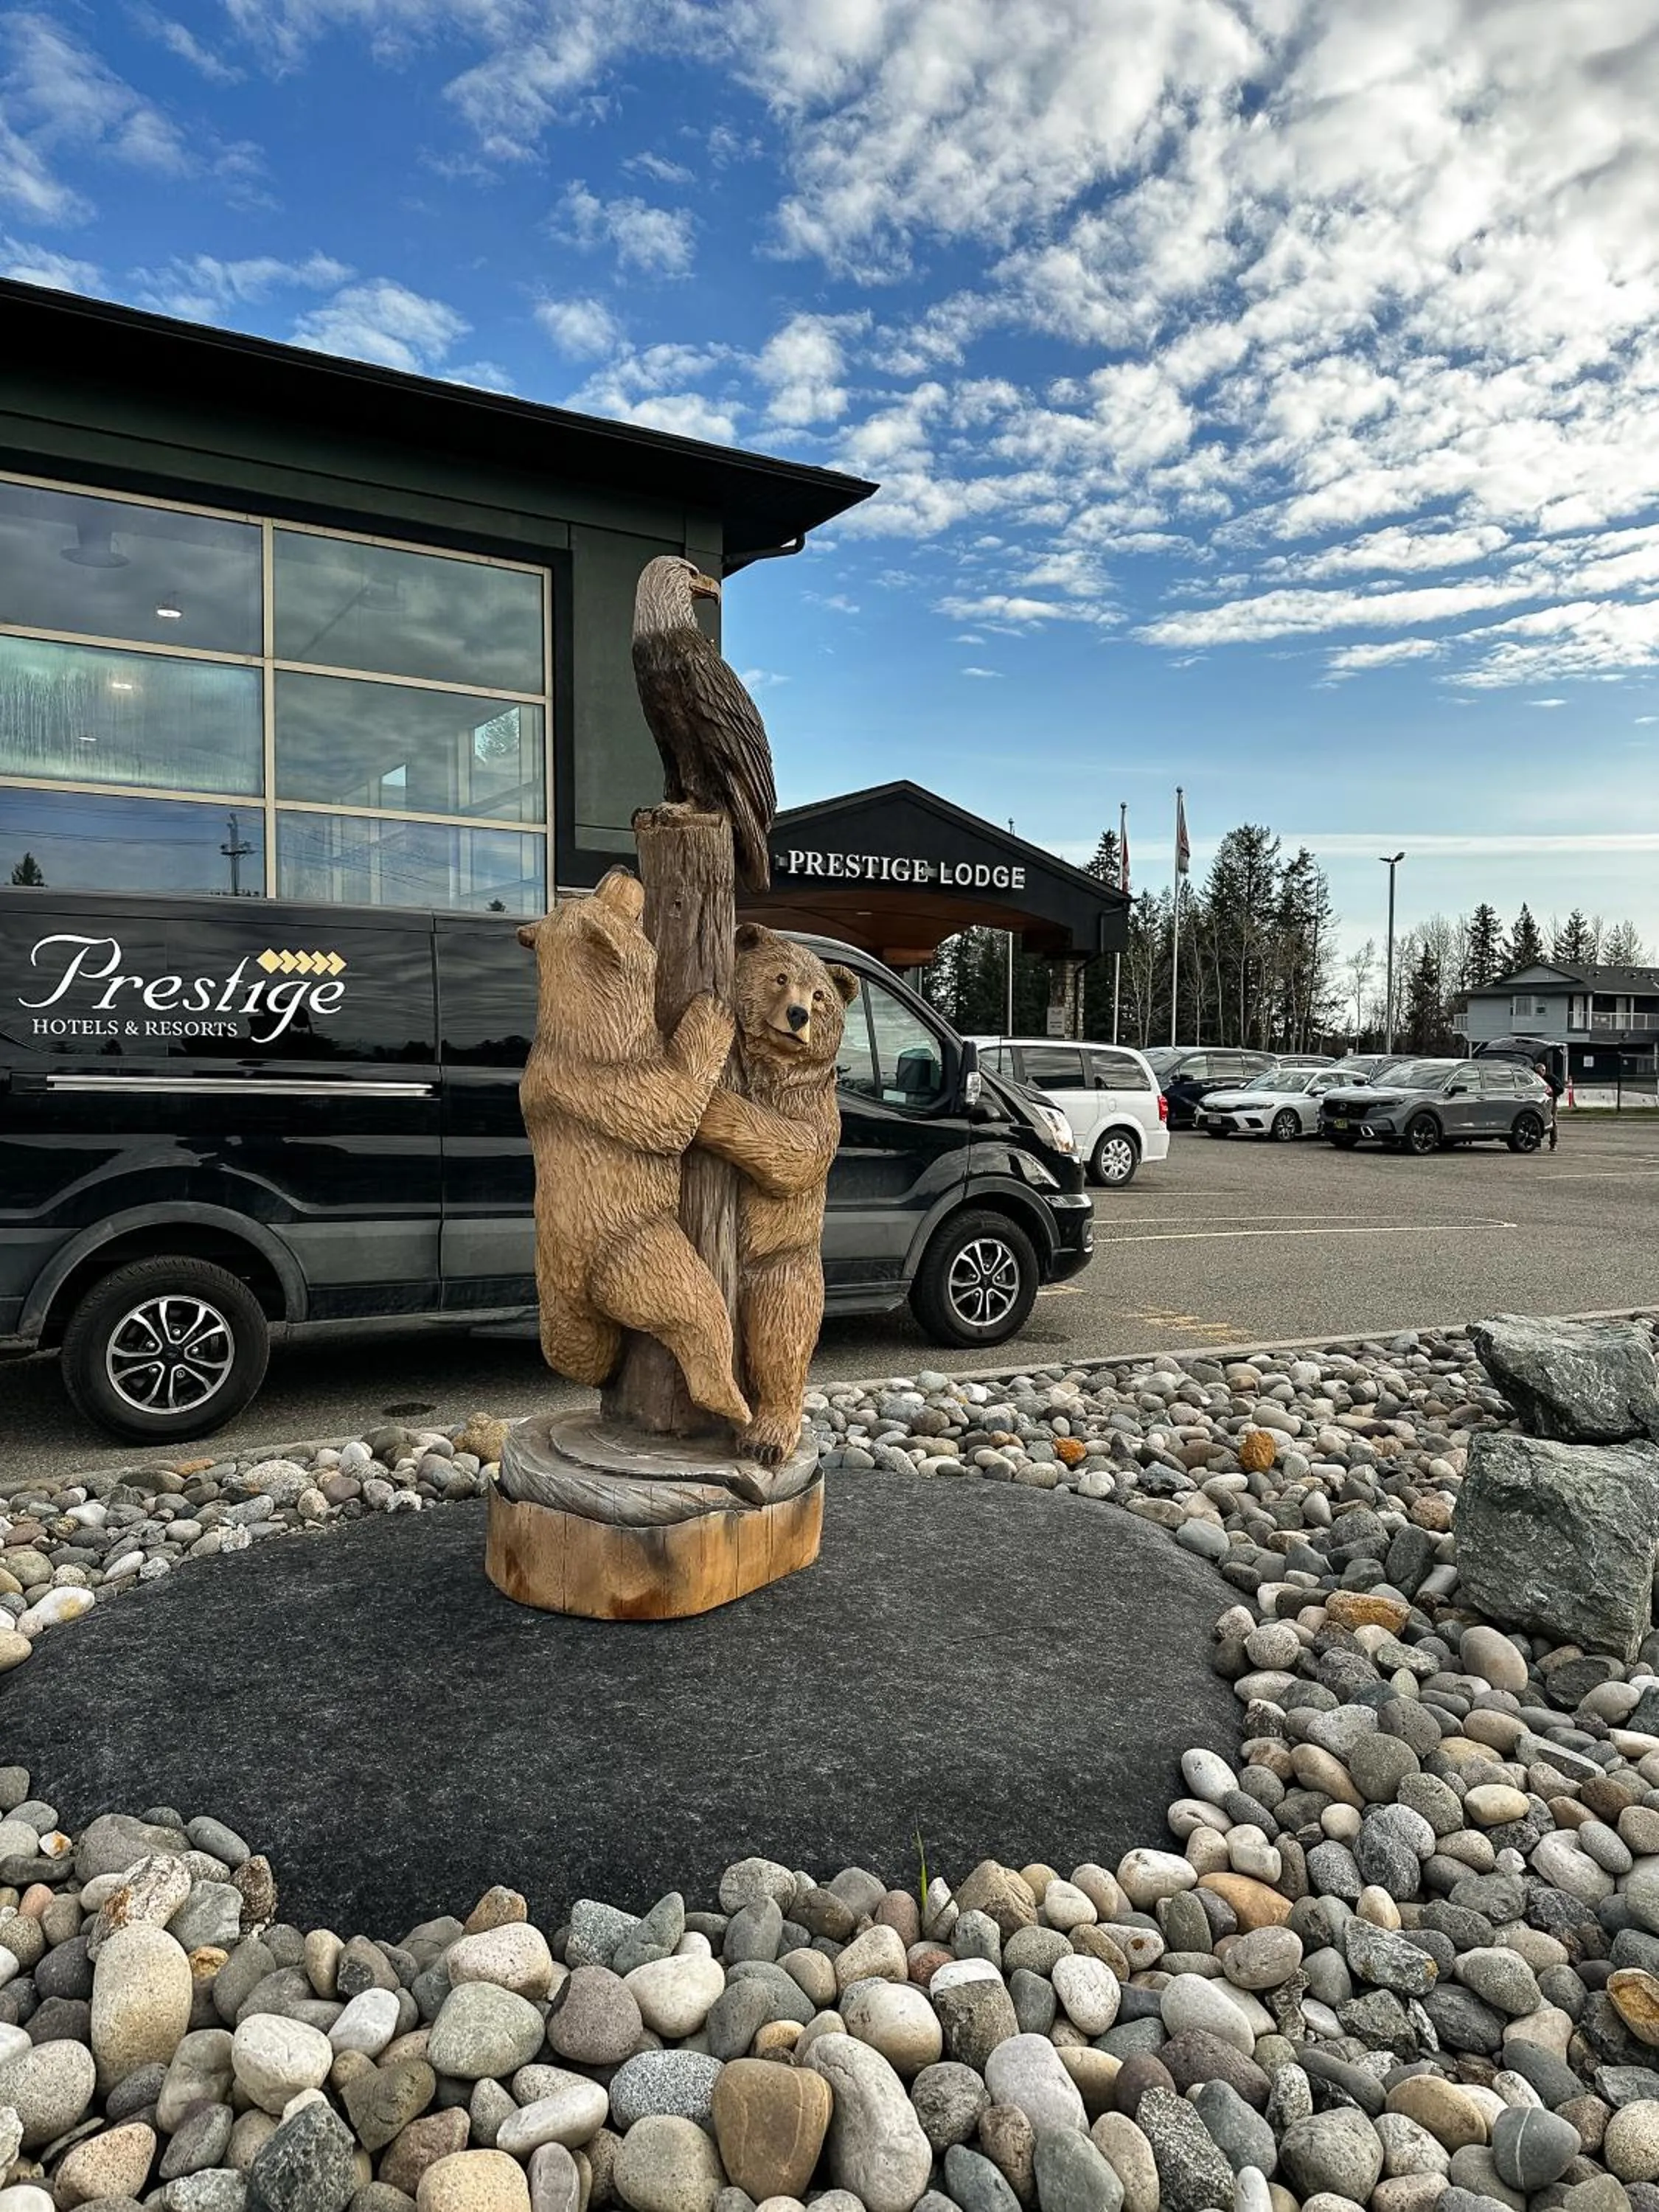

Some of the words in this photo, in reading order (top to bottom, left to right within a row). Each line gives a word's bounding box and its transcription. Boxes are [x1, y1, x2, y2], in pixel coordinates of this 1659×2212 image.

[787, 849, 929, 883] PRESTIGE
[940, 861, 1026, 889] LODGE
[18, 934, 346, 1043] Prestige
[32, 1018, 119, 1035] HOTELS
[124, 1020, 139, 1036] &
[145, 1020, 238, 1037] RESORTS
